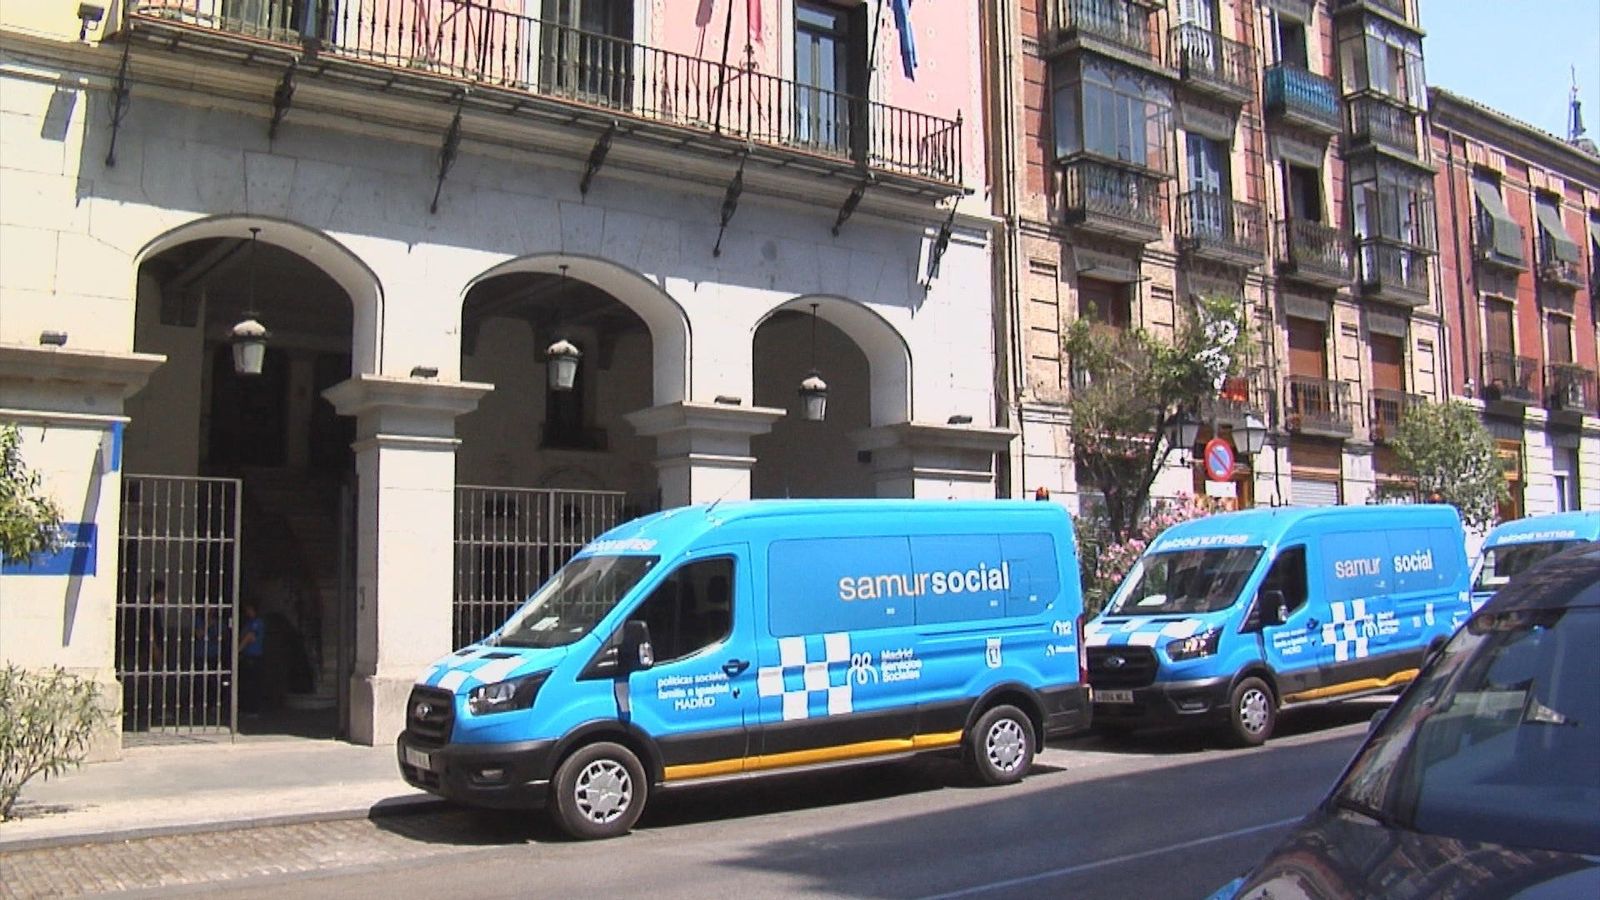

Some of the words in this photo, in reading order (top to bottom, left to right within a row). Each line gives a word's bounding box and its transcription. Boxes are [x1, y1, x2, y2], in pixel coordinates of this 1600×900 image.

[1335, 558, 1380, 578] samur
[1393, 549, 1432, 573] social
[839, 561, 1009, 601] samursocial
[881, 648, 914, 660] Madrid
[674, 696, 715, 710] MADRID
